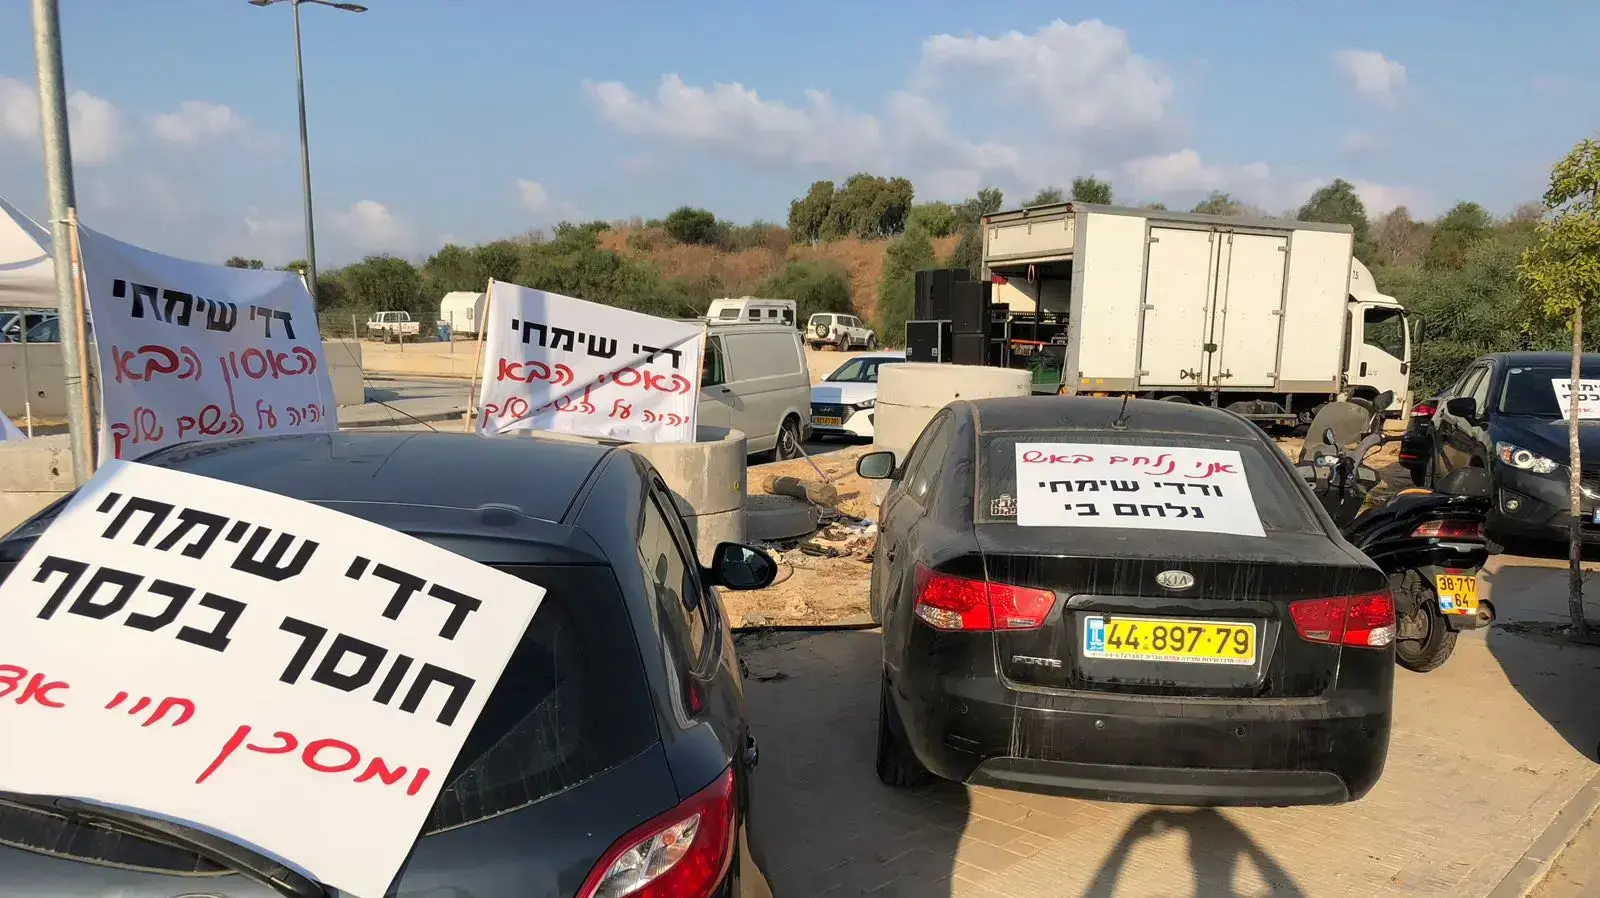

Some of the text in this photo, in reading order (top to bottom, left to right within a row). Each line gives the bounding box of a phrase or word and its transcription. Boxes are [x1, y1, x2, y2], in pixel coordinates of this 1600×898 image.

[112, 279, 296, 339] דדי שימחי
[512, 319, 682, 368] דדי שימחי
[112, 345, 317, 413] האסון הבא
[497, 358, 574, 387] הבא
[482, 397, 529, 428] שלך
[609, 399, 633, 419] על
[641, 410, 690, 427] יהיה
[111, 399, 325, 459] יהיה על השם שלך
[1022, 450, 1238, 478] אני נלחם באש
[1039, 479, 1223, 497] ודדי שימחי
[1064, 502, 1205, 518] נלחם בי
[96, 493, 483, 640] דדי שימחי
[1455, 593, 1469, 607] 64
[32, 556, 476, 727] חוסך בכסף
[1012, 655, 1062, 668] FORTE
[104, 691, 195, 727] חיי
[195, 725, 430, 796] ומסכן
